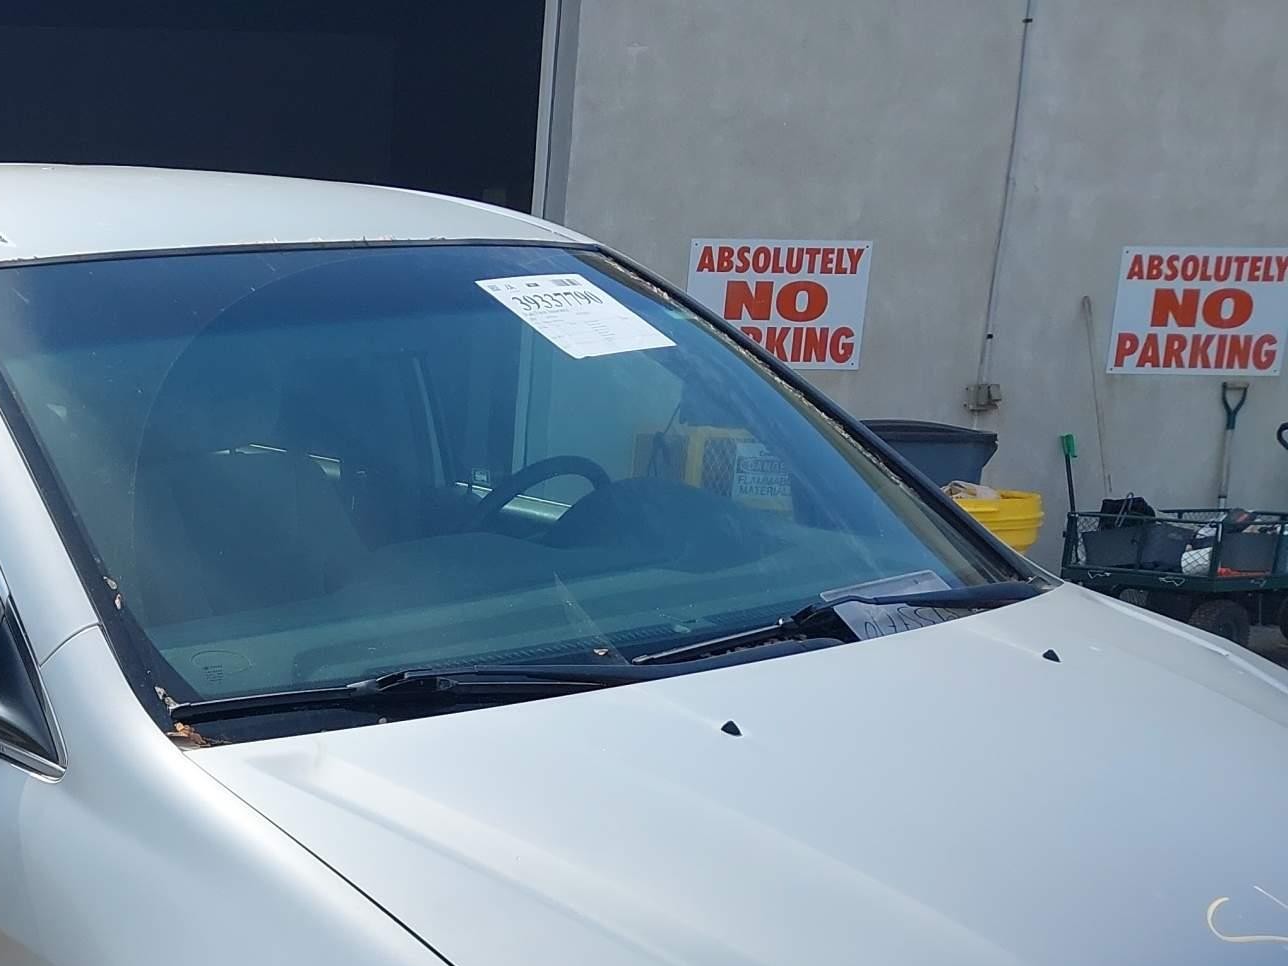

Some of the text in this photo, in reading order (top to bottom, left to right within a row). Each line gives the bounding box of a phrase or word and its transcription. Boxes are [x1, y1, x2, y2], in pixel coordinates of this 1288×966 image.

[696, 246, 864, 275] ABSOLUTELY
[1126, 254, 1288, 282] ABSOLUTELY
[511, 290, 603, 311] 39337790
[724, 280, 828, 322] NO
[1150, 287, 1253, 329] NO
[740, 326, 855, 364] KING
[1114, 332, 1278, 370] PARKING
